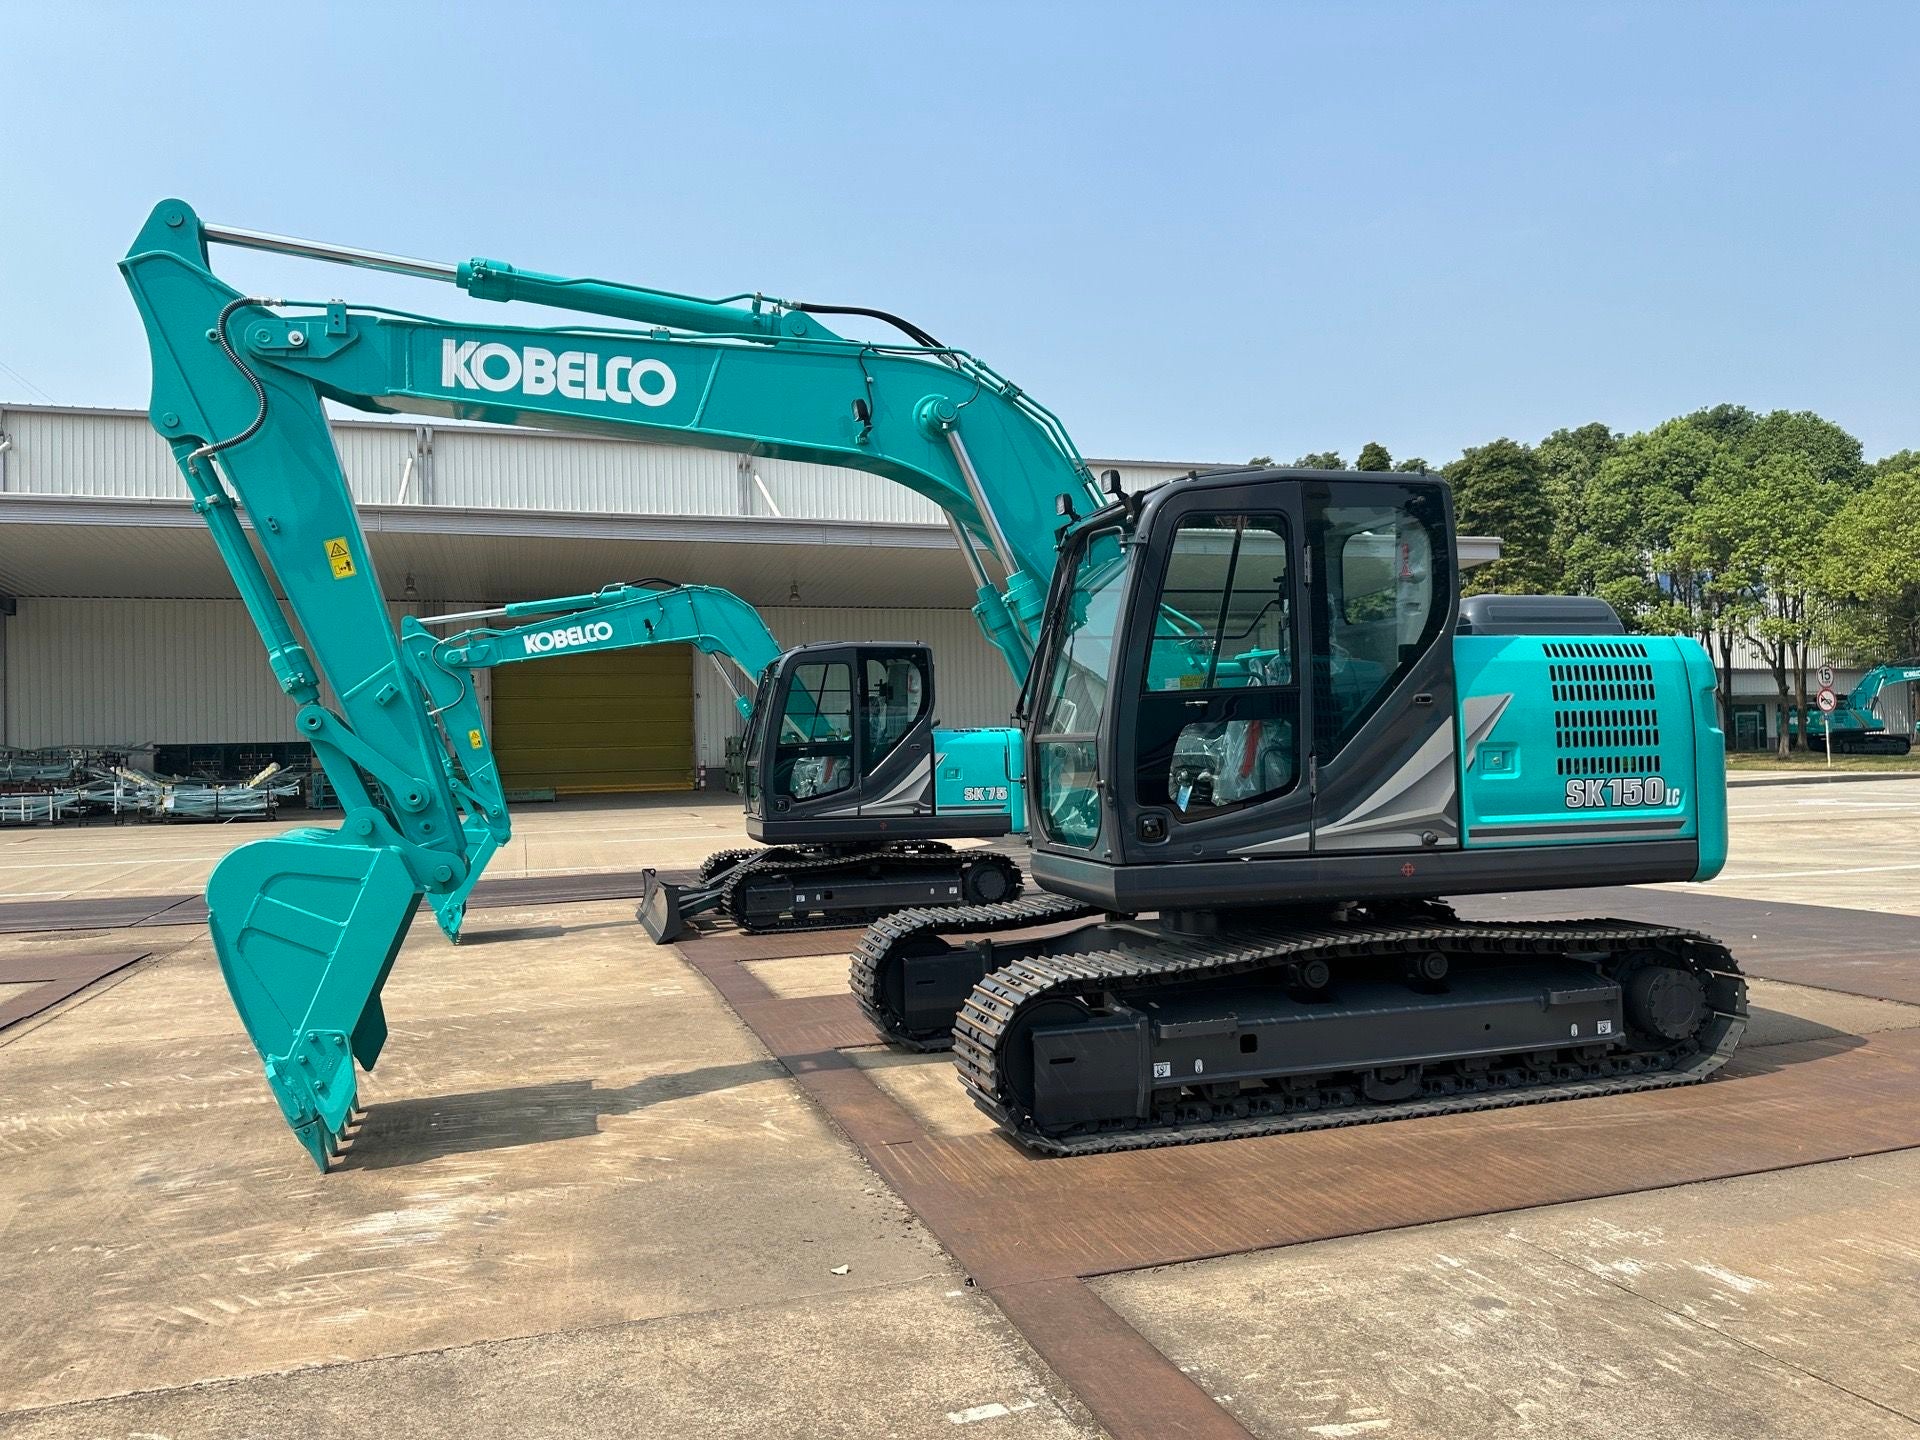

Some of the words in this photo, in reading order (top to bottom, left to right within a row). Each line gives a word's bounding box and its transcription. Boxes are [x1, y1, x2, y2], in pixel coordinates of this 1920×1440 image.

[441, 338, 677, 407] KOBELCO
[522, 621, 613, 654] KOBELCO
[1819, 668, 1831, 681] 15
